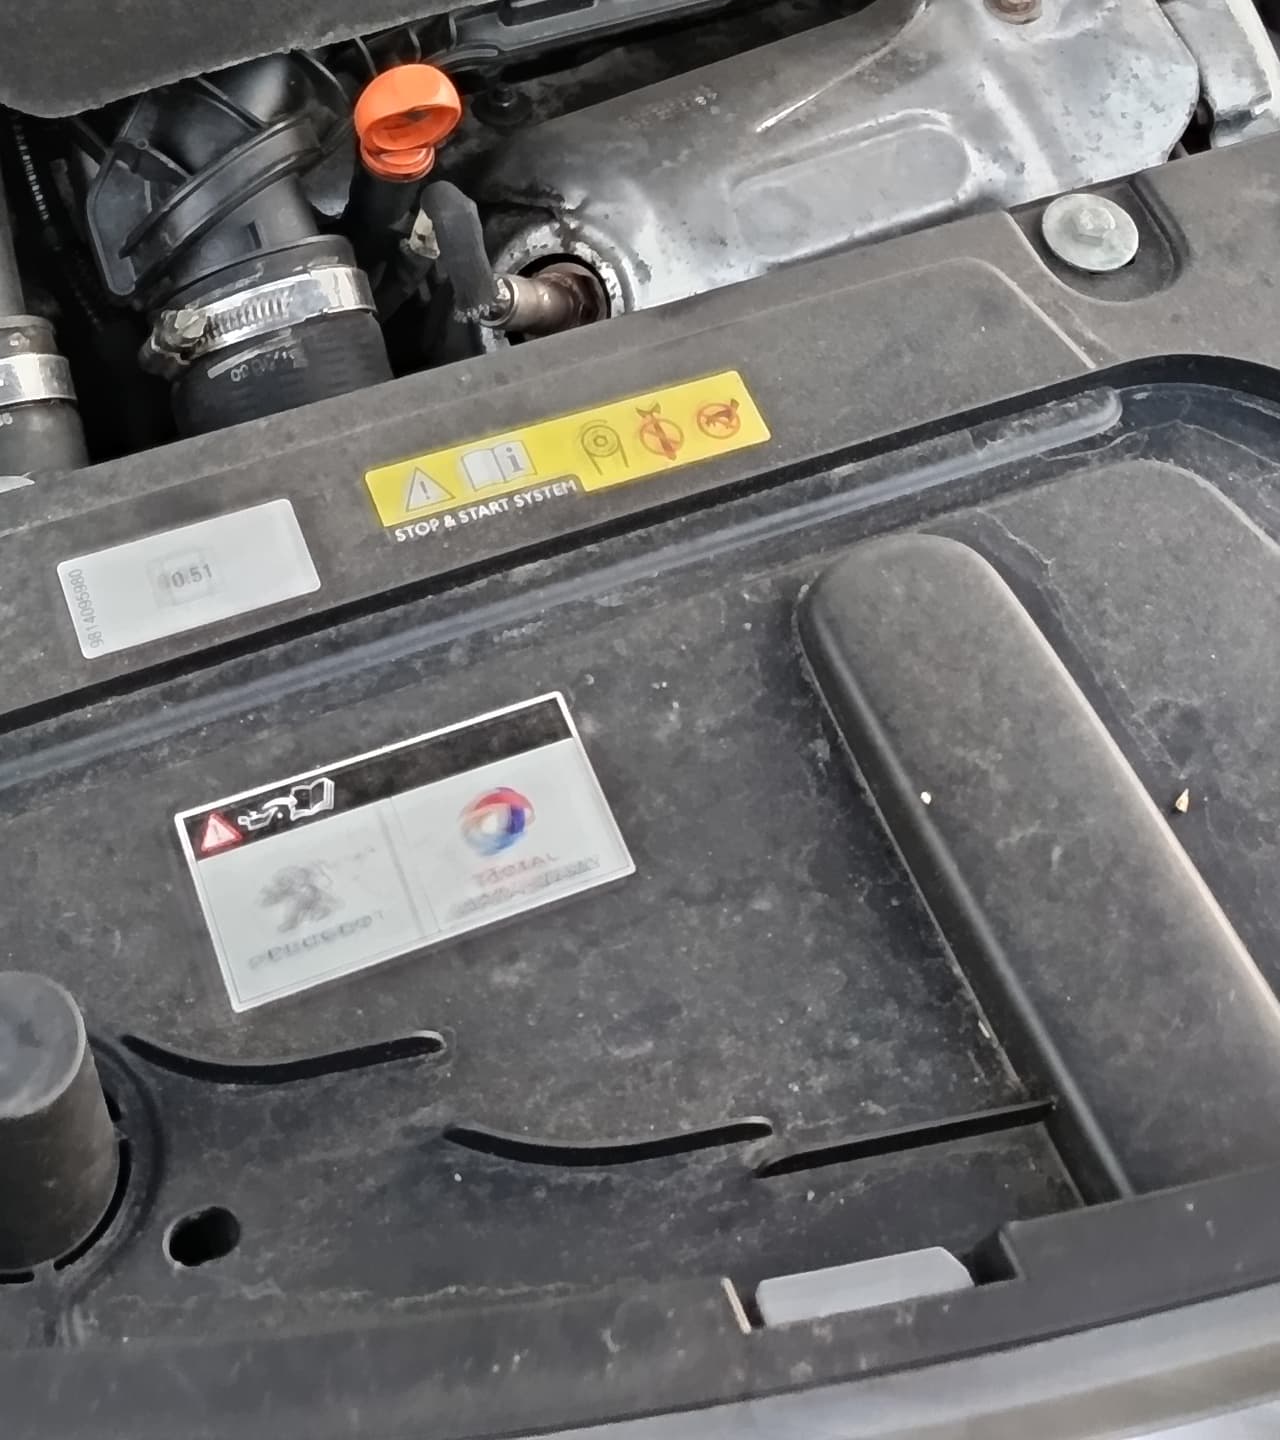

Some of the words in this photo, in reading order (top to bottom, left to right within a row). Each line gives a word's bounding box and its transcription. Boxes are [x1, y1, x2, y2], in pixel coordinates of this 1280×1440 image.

[395, 518, 440, 542] STOP
[443, 514, 456, 530] &
[459, 498, 509, 525] START
[513, 479, 577, 508] SYSTEM
